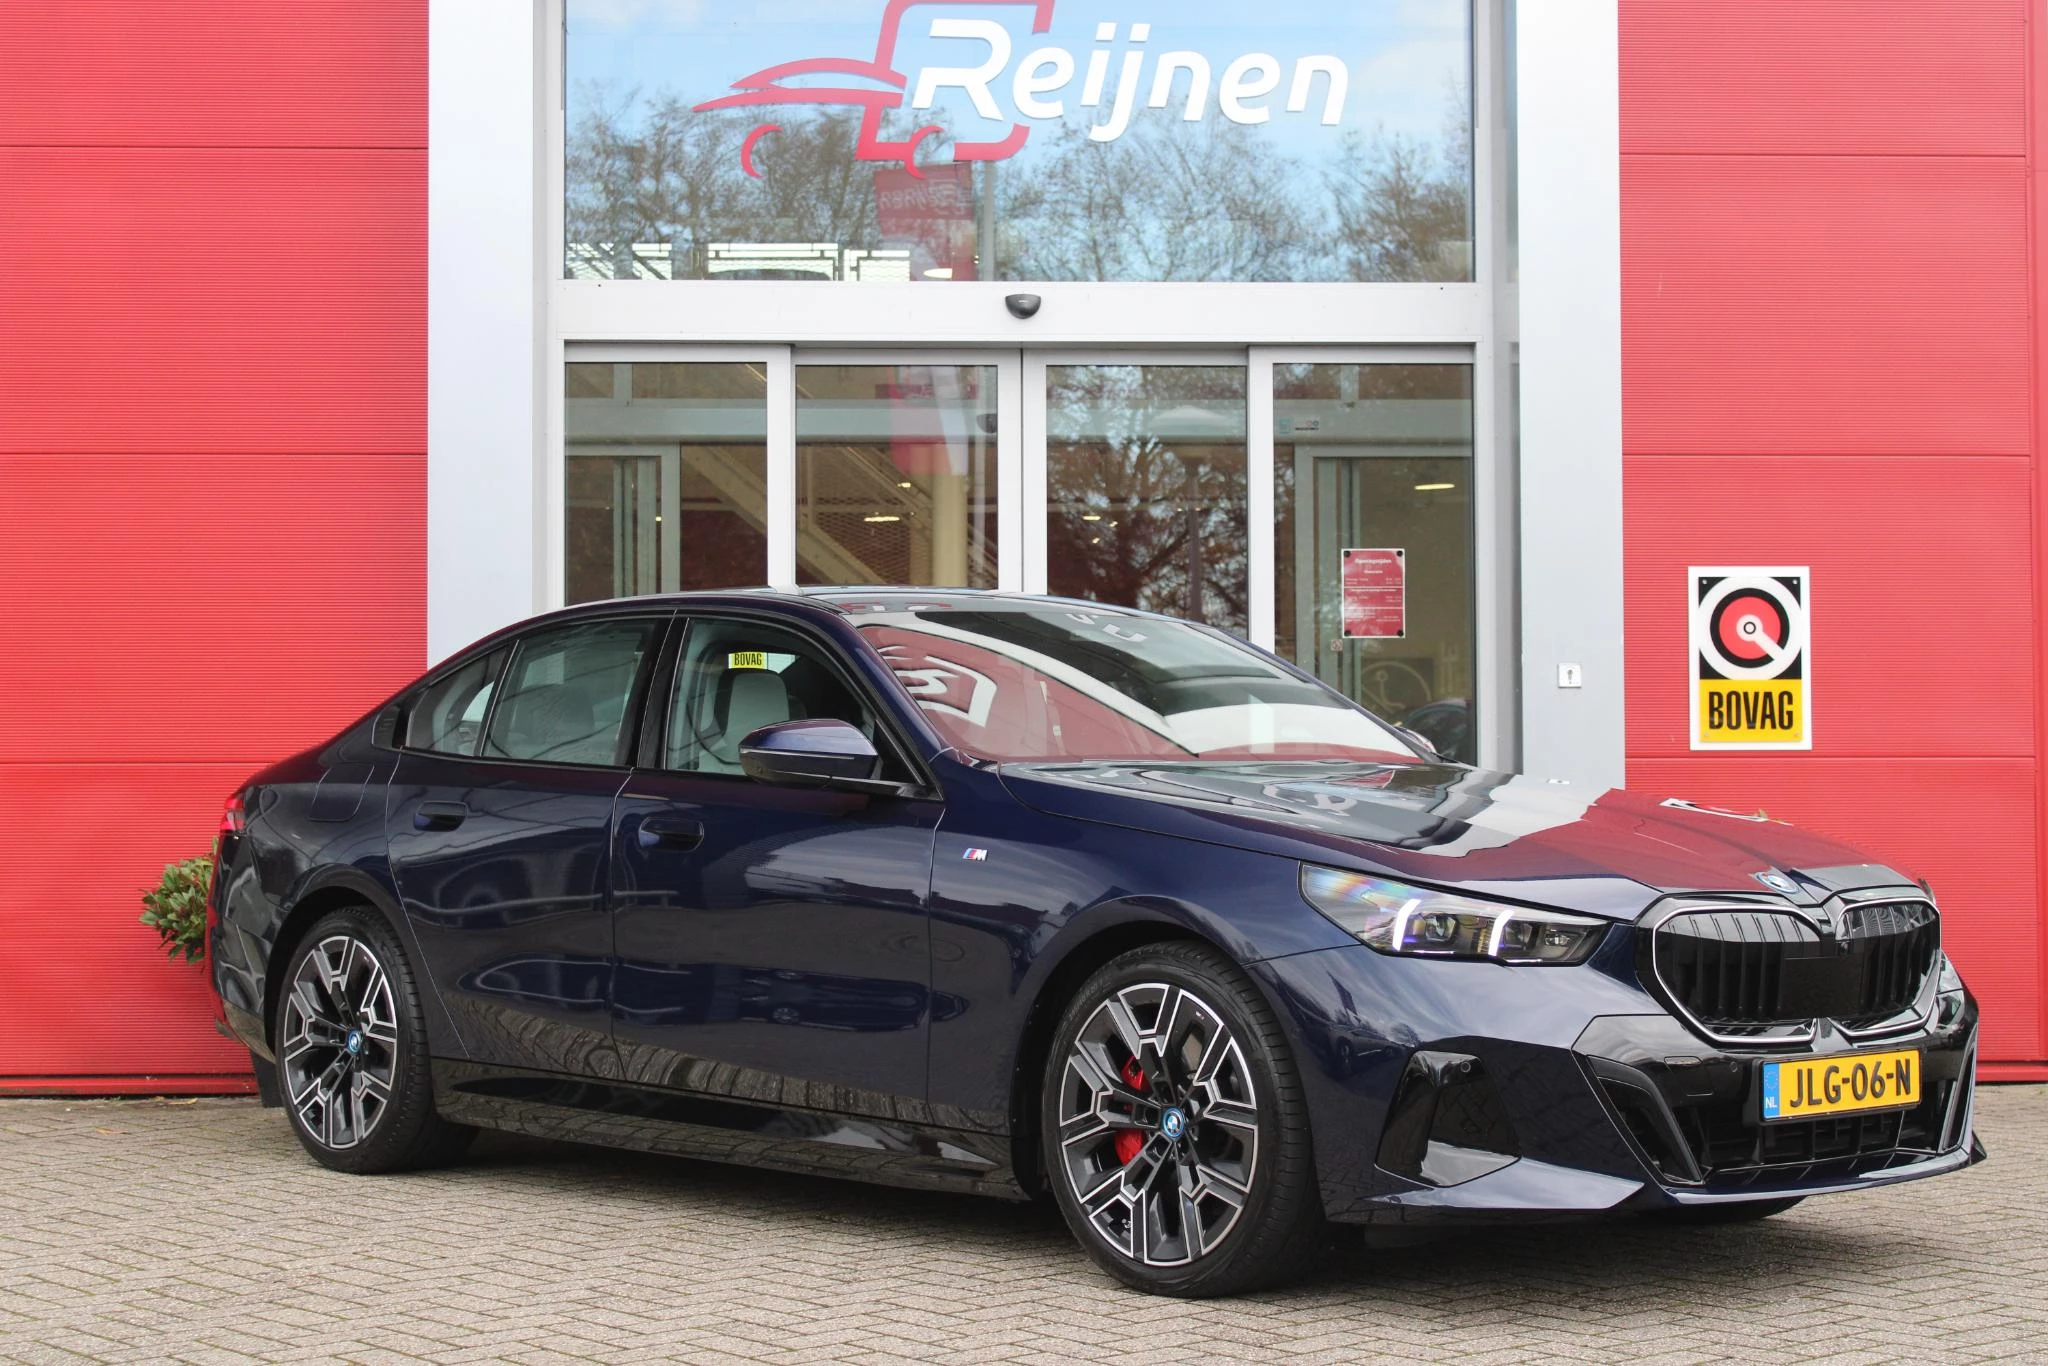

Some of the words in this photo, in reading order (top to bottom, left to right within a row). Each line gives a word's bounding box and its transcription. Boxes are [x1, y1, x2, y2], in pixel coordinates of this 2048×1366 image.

[912, 18, 1349, 142] Reijnen
[734, 653, 763, 666] BOVAG
[1708, 690, 1794, 730] BOVAG
[1765, 1096, 1778, 1108] NL
[1789, 1058, 1912, 1108] JLG-06-N
